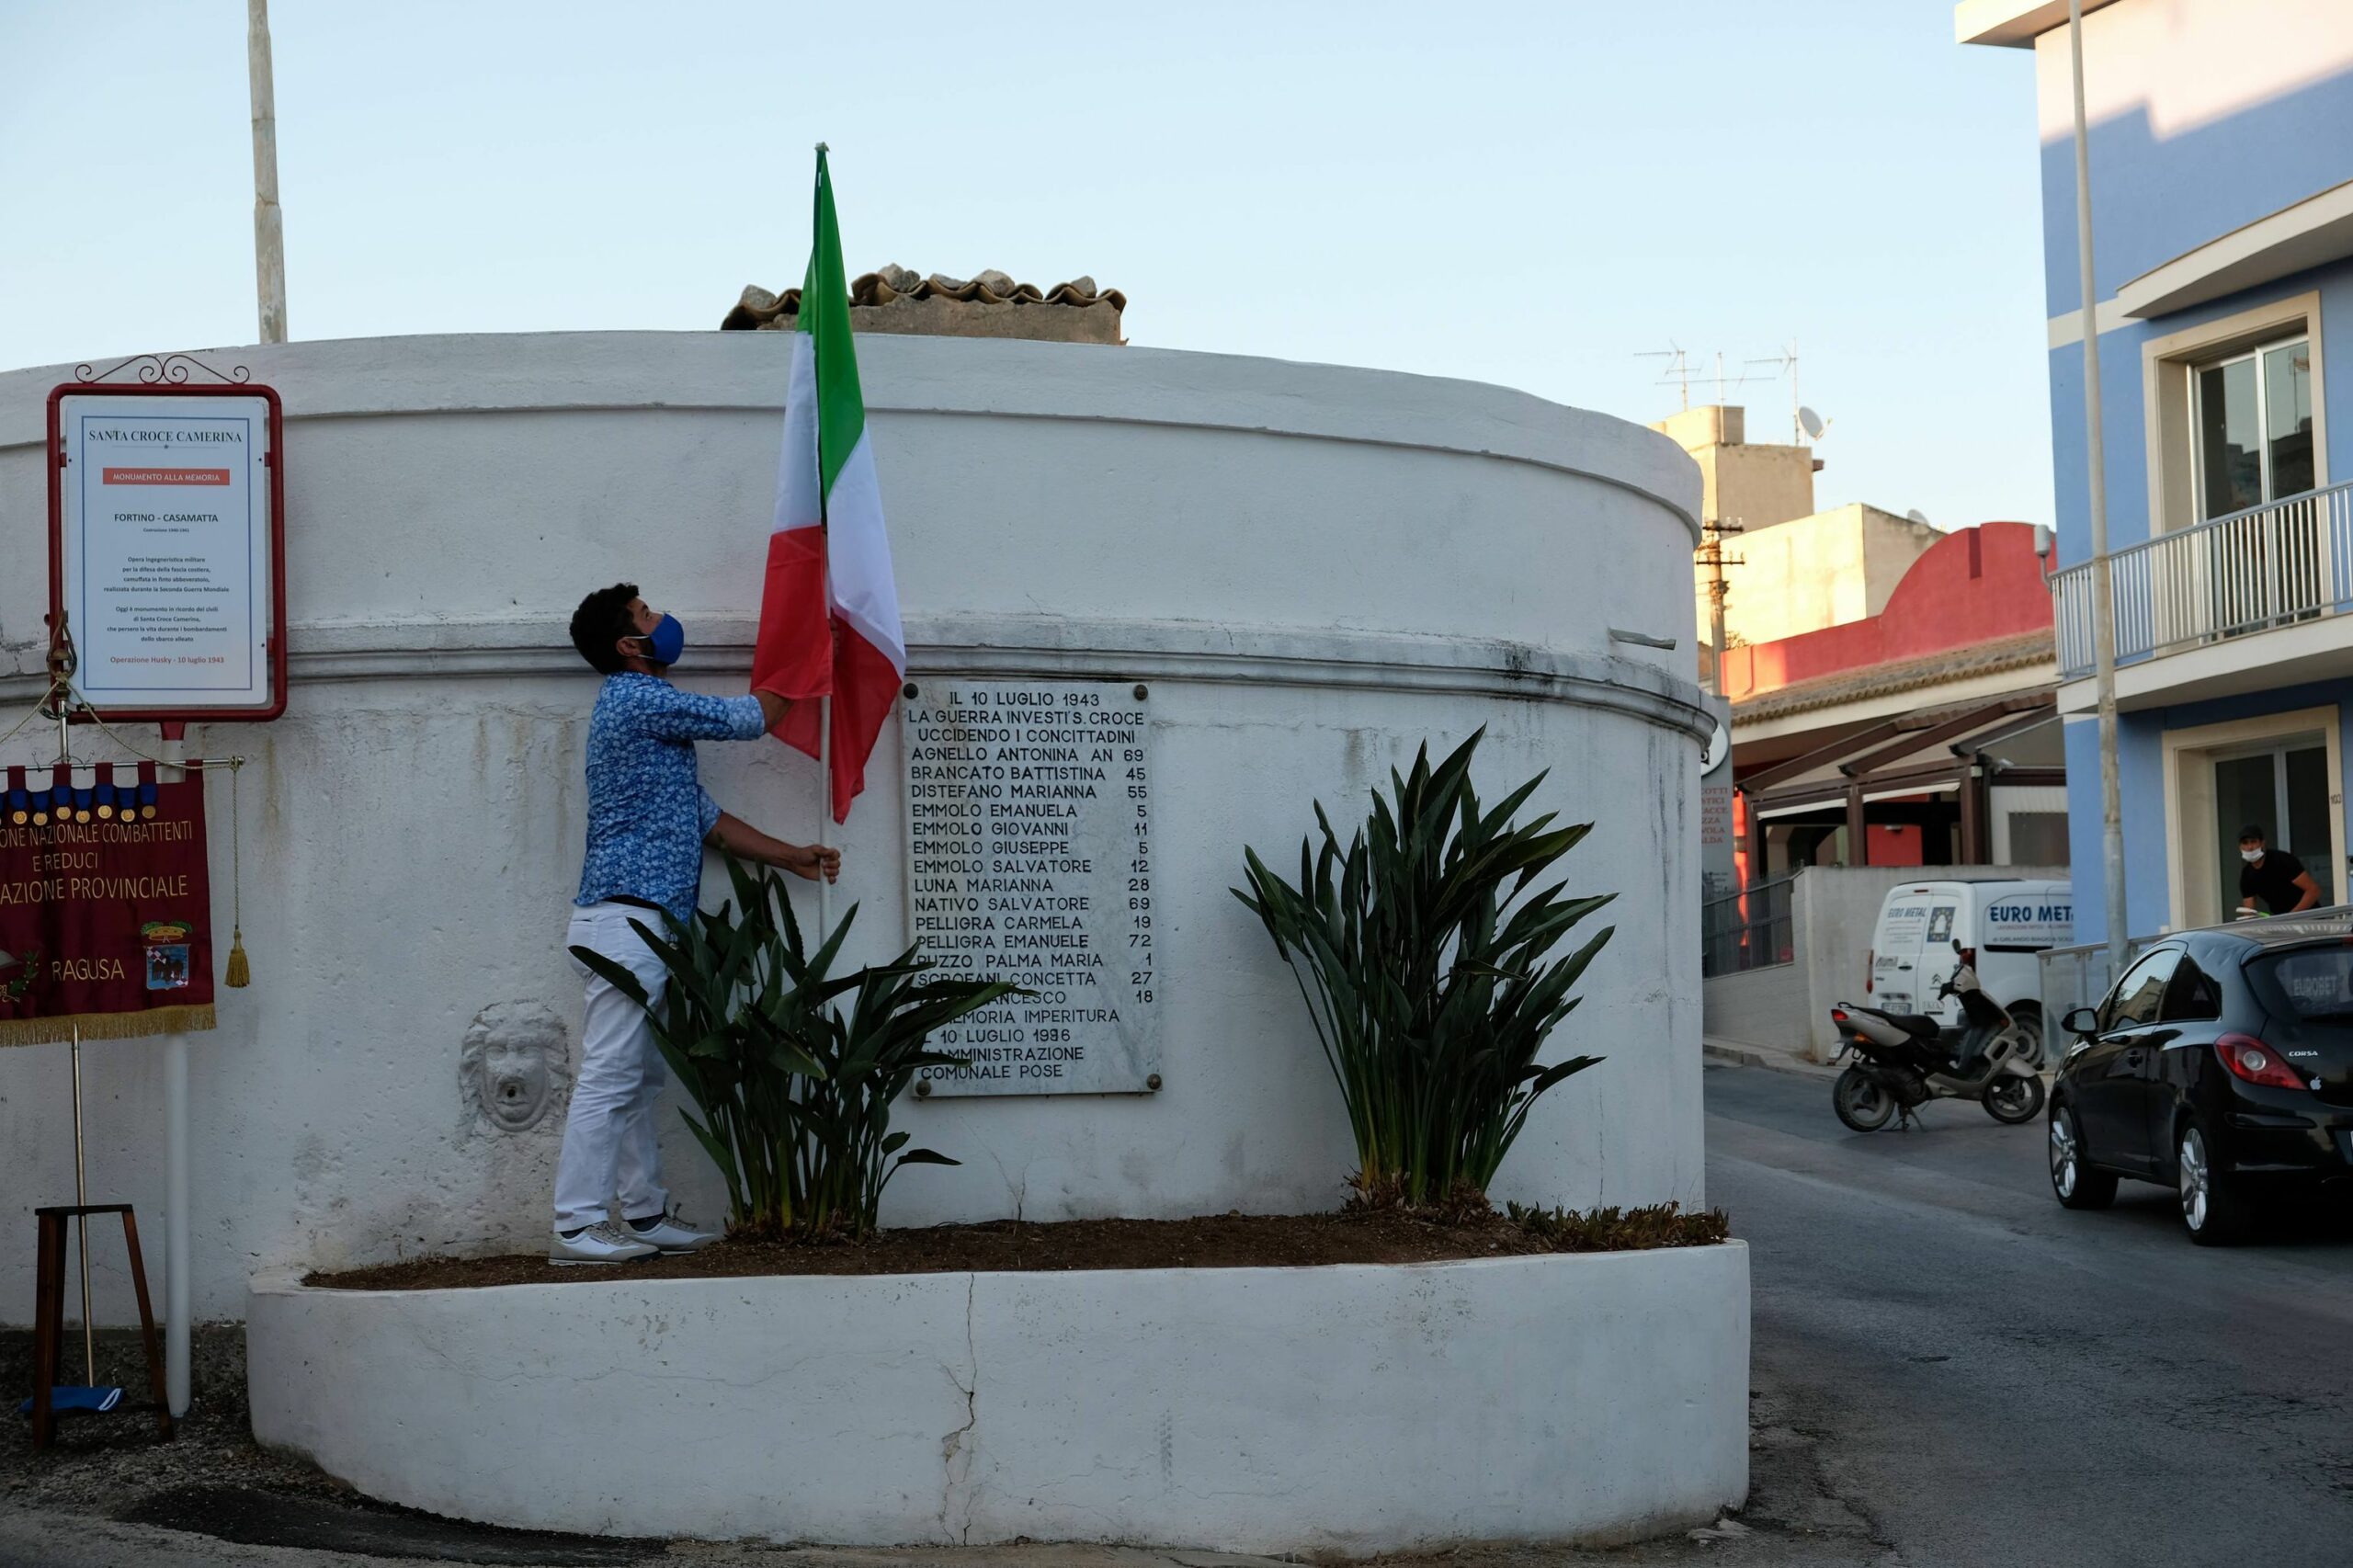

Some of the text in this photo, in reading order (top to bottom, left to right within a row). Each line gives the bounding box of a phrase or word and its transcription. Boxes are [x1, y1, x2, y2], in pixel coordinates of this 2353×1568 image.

[89, 430, 242, 443] SANTA CROCE CAMERINA
[114, 514, 154, 522] FORTINO
[163, 514, 219, 522] CASAMATTA
[110, 656, 149, 665] Operazione
[151, 656, 172, 665] Husky
[187, 656, 206, 665] luglio
[949, 692, 1099, 707] IL 10 LUGLIO 1943
[908, 710, 930, 723] LA
[936, 710, 1002, 724] GUERRA
[1089, 712, 1144, 725] CROCE
[918, 729, 1135, 744] UCCIDENDO I CONCITTADINI
[912, 747, 1144, 762] AGNELLO ANTONINA AN 69
[912, 766, 1146, 780] BRANCATO BATTISTINA 45
[912, 785, 1147, 799] DISTEFANO MARIANNA 55
[913, 804, 1147, 817] EMMOLO EMANUELA 5
[29, 824, 99, 846] NAZIONALE
[102, 821, 193, 844] COMBATTENTI
[913, 823, 1148, 835] EMMOLO GIOVANNI 11
[914, 841, 1149, 855] EMMOLO GIUSEPPE 5
[32, 852, 98, 872] E REDUCI
[914, 859, 1150, 873] EMMOLO SALVATORE 12
[71, 875, 189, 900] PROVINCIALE
[915, 879, 1150, 892] LUNA MARIANNA 28
[915, 897, 1150, 911] NATIVO SALVATORE 69
[1990, 905, 2074, 923] EURO MET
[915, 916, 1151, 931] PELLIGRA CARMELA 19
[917, 934, 1152, 949] PELLIGRA EMANUELE 72
[986, 954, 1042, 968] PALMA
[1051, 953, 1104, 967] MARIA
[1145, 953, 1153, 966] 1
[51, 959, 125, 982] RAGUSA
[1010, 972, 1097, 985] CONCETTA
[1131, 971, 1153, 984] 27
[1135, 990, 1154, 1004] 18
[1025, 1009, 1120, 1023] IMPERITURA
[940, 1030, 958, 1044] 10
[966, 1029, 1024, 1043] LUGLIO
[921, 1064, 1063, 1080] COMUNALE POSE
